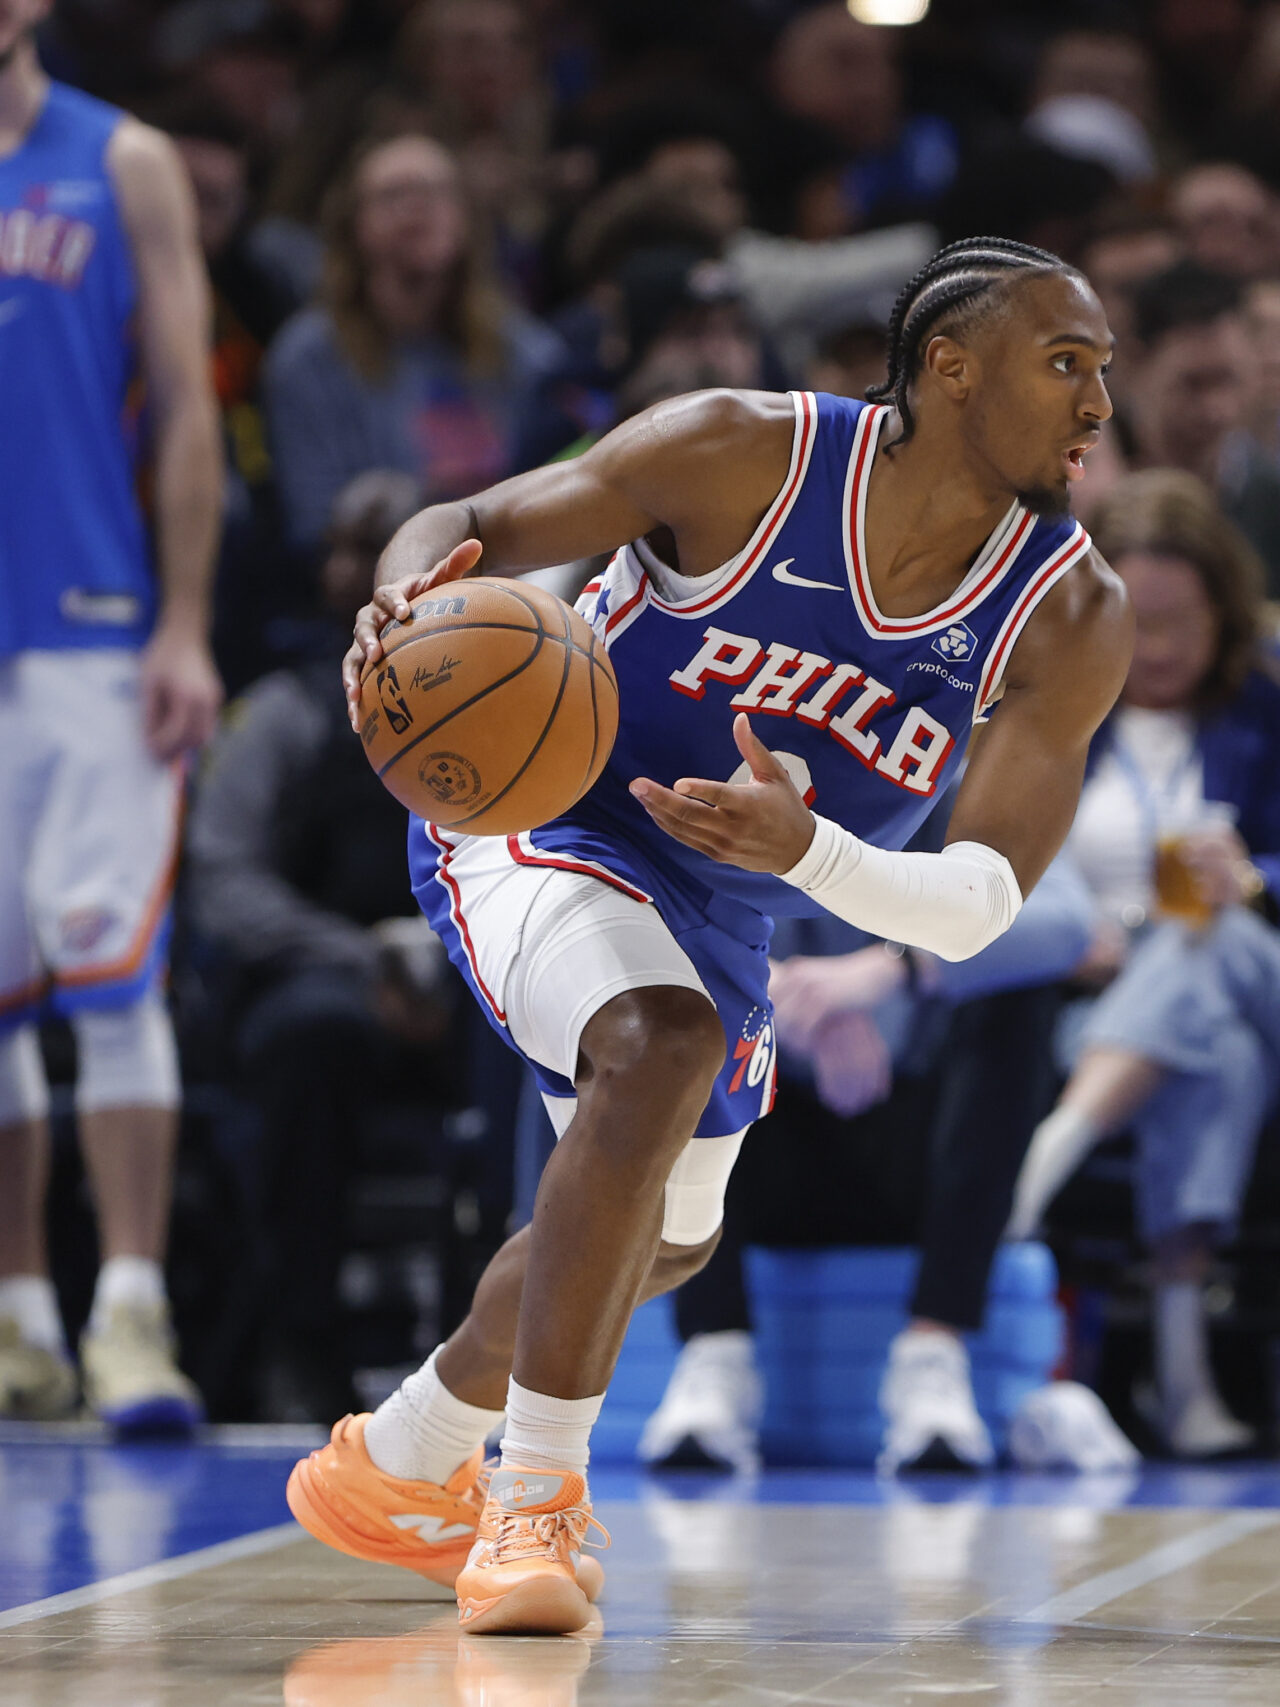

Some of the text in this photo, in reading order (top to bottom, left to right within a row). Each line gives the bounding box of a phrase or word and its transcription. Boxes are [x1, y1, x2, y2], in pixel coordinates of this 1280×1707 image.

[669, 626, 955, 798] PHILA
[906, 662, 975, 693] crypto.com
[727, 1024, 772, 1095] 76
